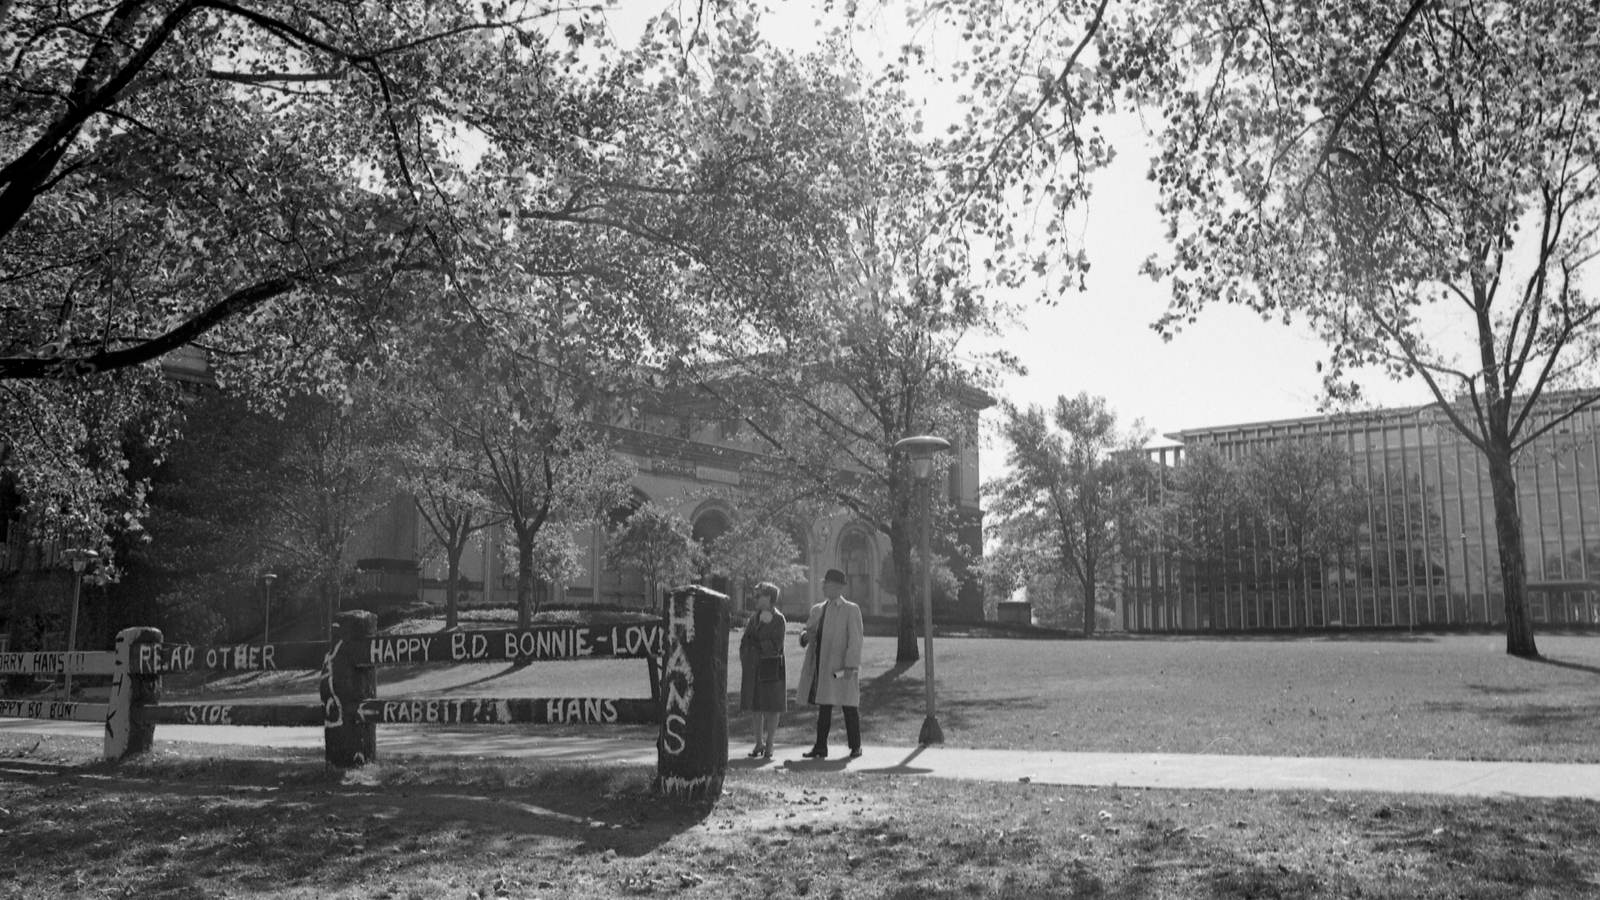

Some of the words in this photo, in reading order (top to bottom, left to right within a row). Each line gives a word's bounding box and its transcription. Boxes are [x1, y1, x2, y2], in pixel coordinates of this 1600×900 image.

[139, 643, 195, 674] READ
[206, 643, 277, 670] OTHER
[370, 637, 431, 663] HAPPY
[451, 632, 489, 660] B.D.
[505, 628, 594, 658] BONNIE
[663, 595, 695, 755] HANS
[186, 705, 232, 725] SIDE
[547, 698, 619, 724] HANS
